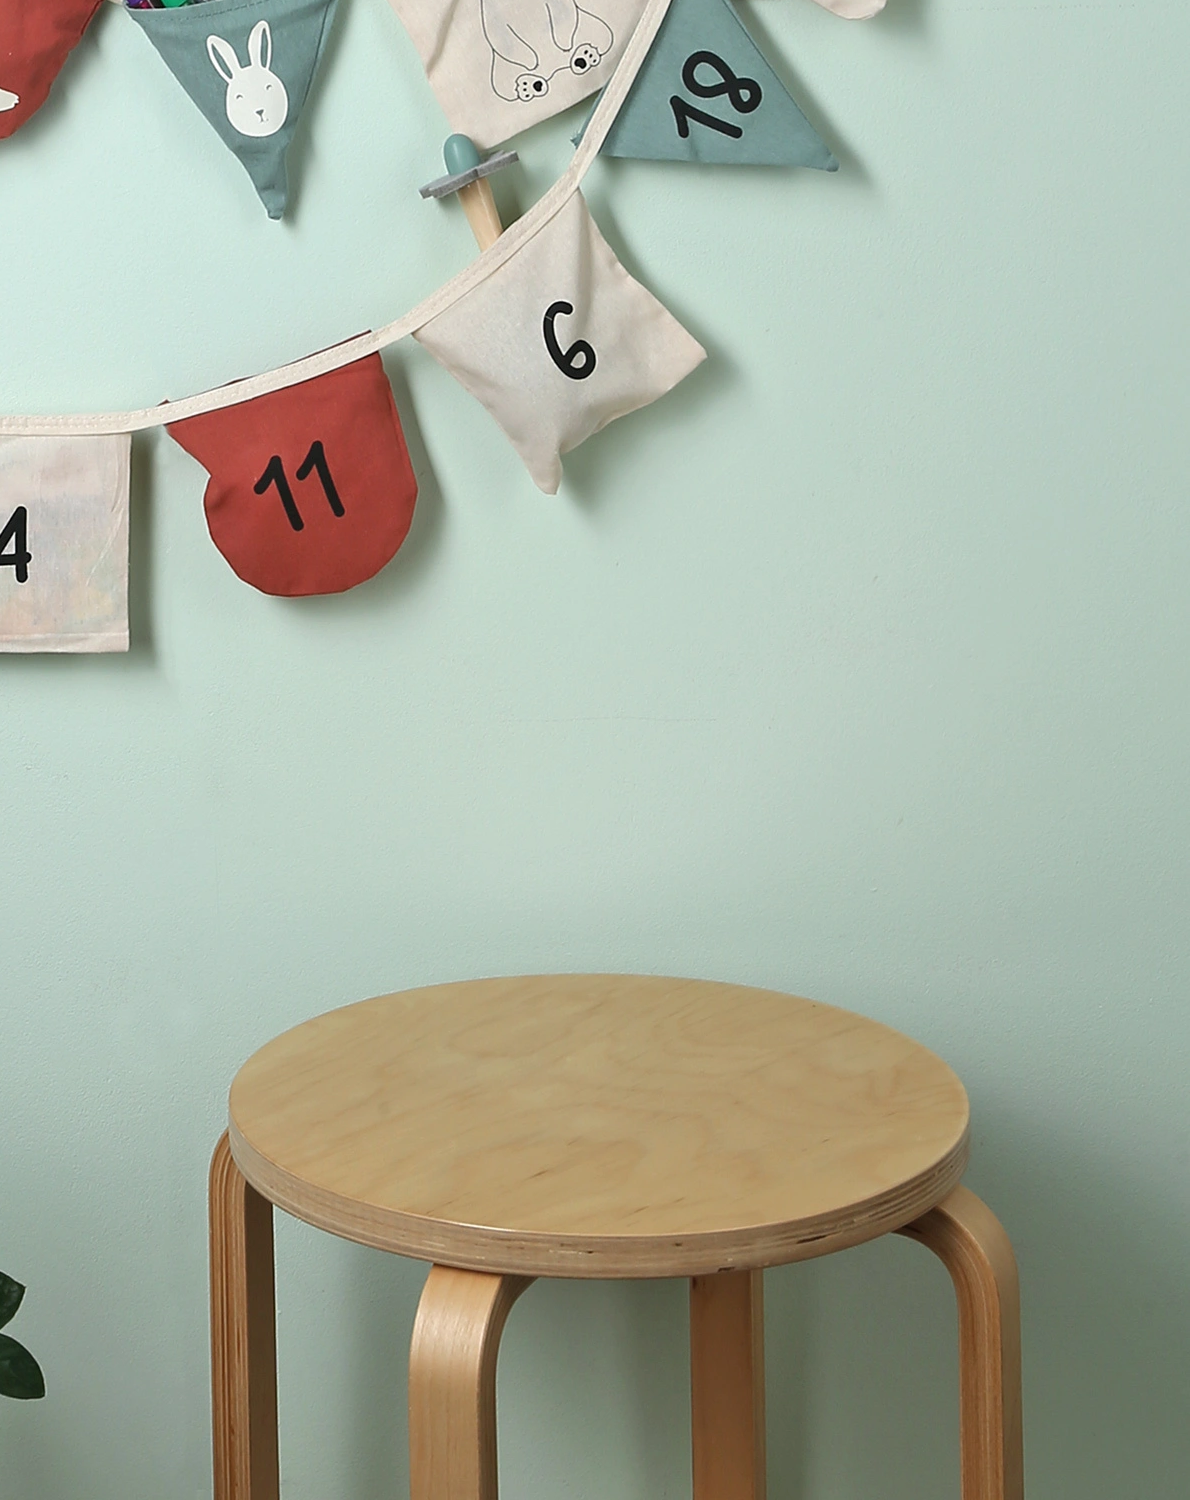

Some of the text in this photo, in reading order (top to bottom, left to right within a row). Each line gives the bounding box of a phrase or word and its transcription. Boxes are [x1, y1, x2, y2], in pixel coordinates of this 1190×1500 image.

[669, 50, 763, 139] 18
[543, 301, 597, 380] 6
[253, 440, 345, 532] 11
